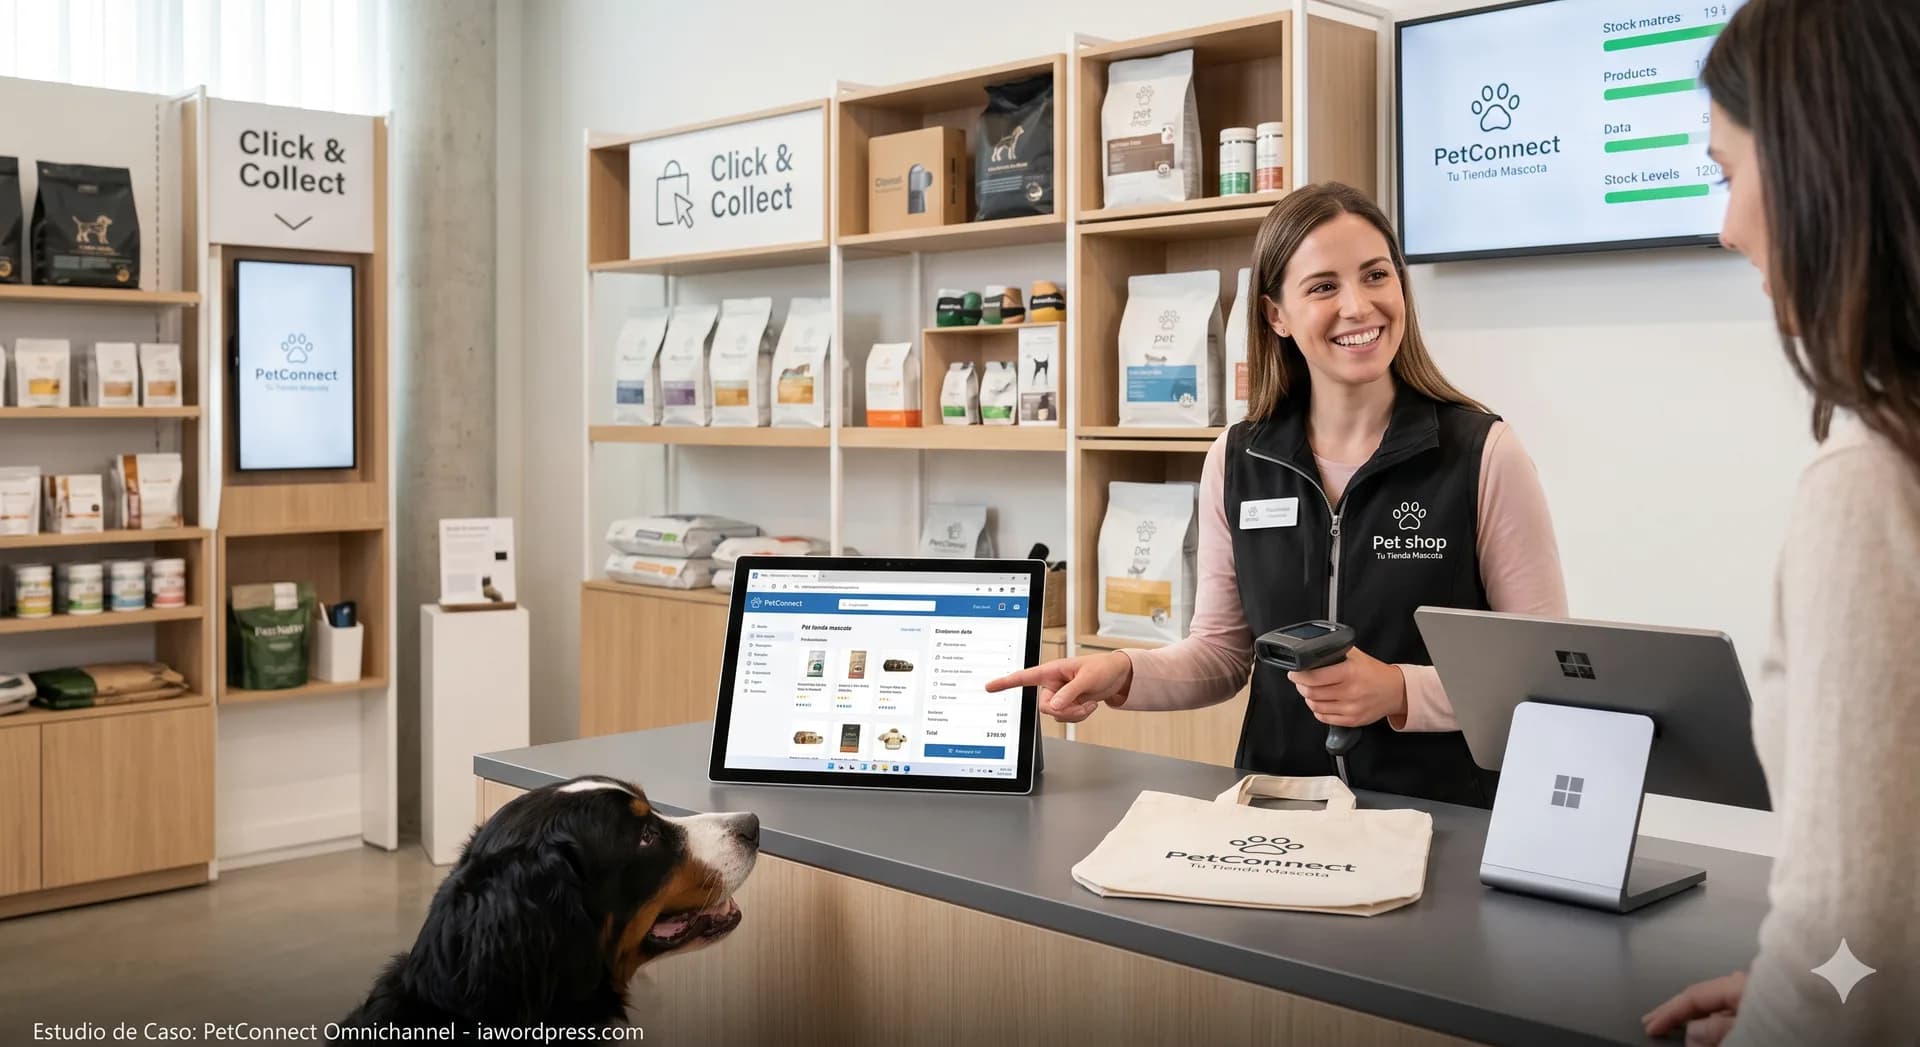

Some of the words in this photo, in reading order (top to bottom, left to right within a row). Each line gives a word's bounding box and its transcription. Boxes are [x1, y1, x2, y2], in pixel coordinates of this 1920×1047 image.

[1602, 20, 1637, 34] Stock
[1639, 13, 1681, 29] matres
[1603, 66, 1657, 82] Products
[1604, 121, 1632, 135] Data
[239, 130, 315, 160] Click
[324, 139, 346, 164] &
[1434, 135, 1561, 166] PetConnect
[711, 146, 768, 182] Click
[776, 143, 793, 173] &
[239, 163, 346, 195] Collect
[1447, 171, 1459, 182] Tu
[1462, 168, 1498, 181] Tienda
[1500, 163, 1548, 177] Mascota
[1604, 172, 1638, 186] Stock
[1641, 168, 1680, 184] Levels
[711, 182, 793, 218] Collect
[255, 368, 338, 382] PetConnect
[1373, 535, 1401, 550] Pet
[1405, 535, 1447, 552] shop
[1376, 552, 1386, 560] Tu
[1387, 552, 1411, 560] Tienda
[1412, 552, 1443, 560] Mascota
[764, 599, 803, 608] PetConnect
[1165, 850, 1357, 874] PetConnect
[1190, 862, 1207, 870] Tu
[1211, 864, 1260, 874] Tienda
[1265, 868, 1331, 878] Mascota
